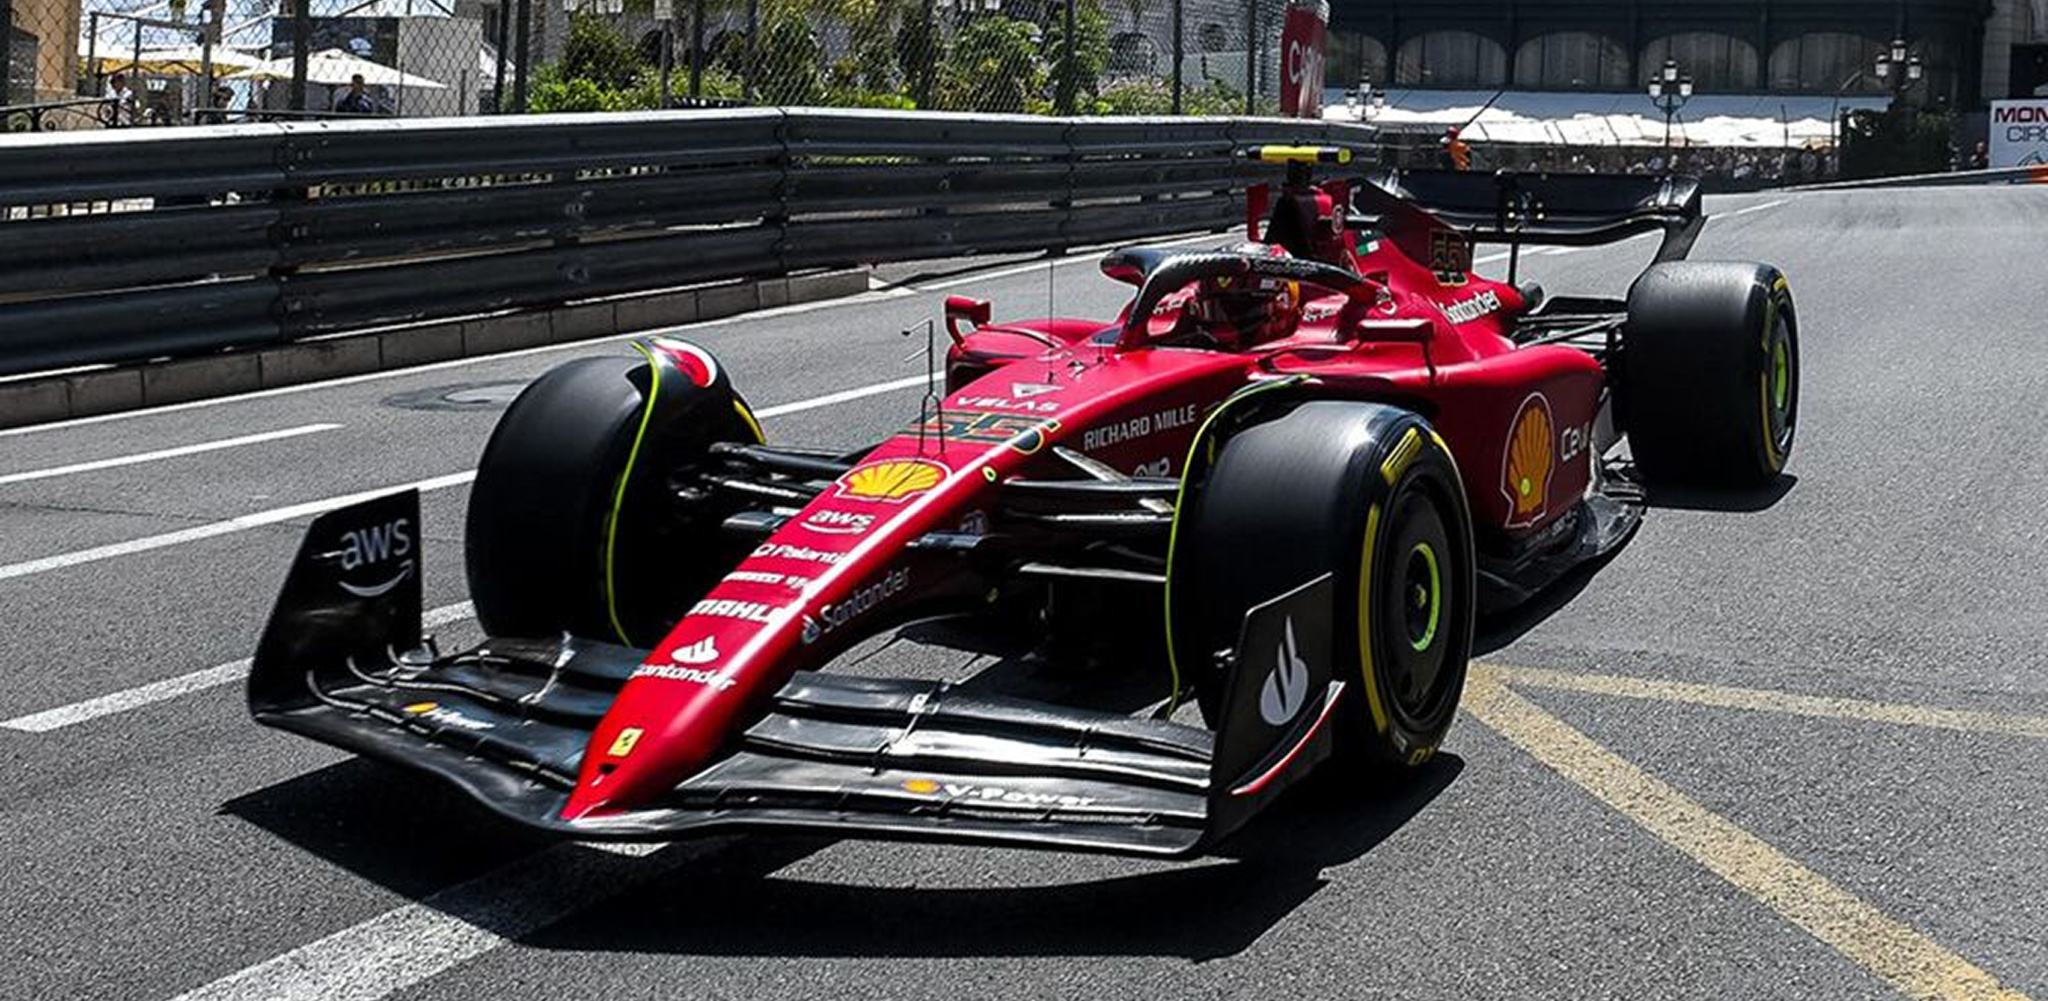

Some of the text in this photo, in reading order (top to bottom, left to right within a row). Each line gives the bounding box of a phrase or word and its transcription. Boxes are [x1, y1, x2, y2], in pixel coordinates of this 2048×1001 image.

[1994, 107, 2048, 123] MON
[957, 396, 1061, 412] VELAS
[1084, 403, 1196, 452] RICHARD MILLE
[808, 510, 876, 527] aws
[341, 518, 411, 570] aws
[770, 544, 849, 565] Palanti
[820, 567, 911, 634] Santander
[943, 784, 1096, 806] V-Power
